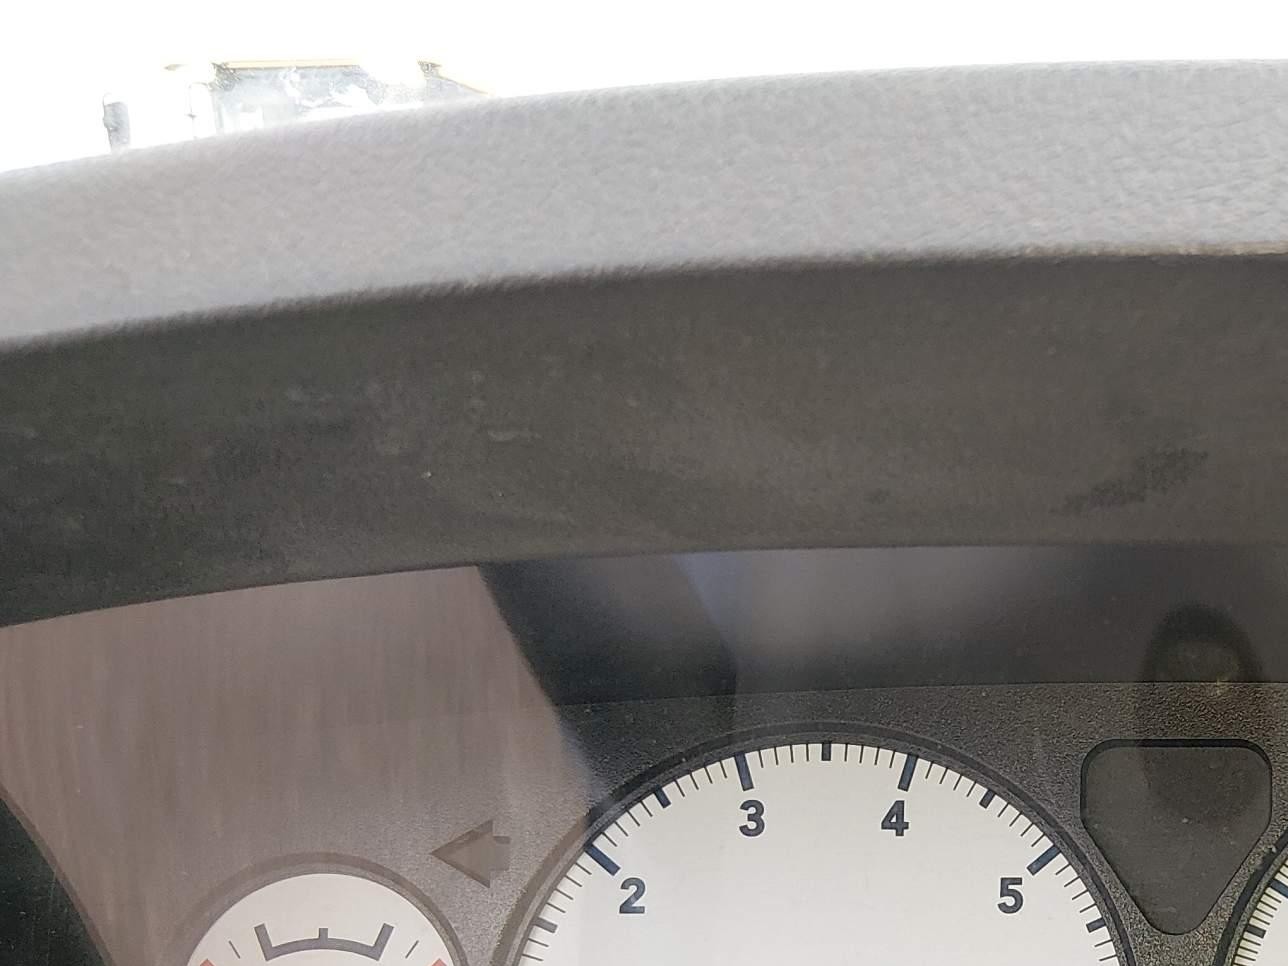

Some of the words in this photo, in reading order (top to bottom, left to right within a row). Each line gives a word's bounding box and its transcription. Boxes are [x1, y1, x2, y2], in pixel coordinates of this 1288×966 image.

[739, 800, 764, 836] 3
[881, 800, 909, 836] 4
[619, 878, 645, 914] 2
[998, 878, 1023, 913] 5
